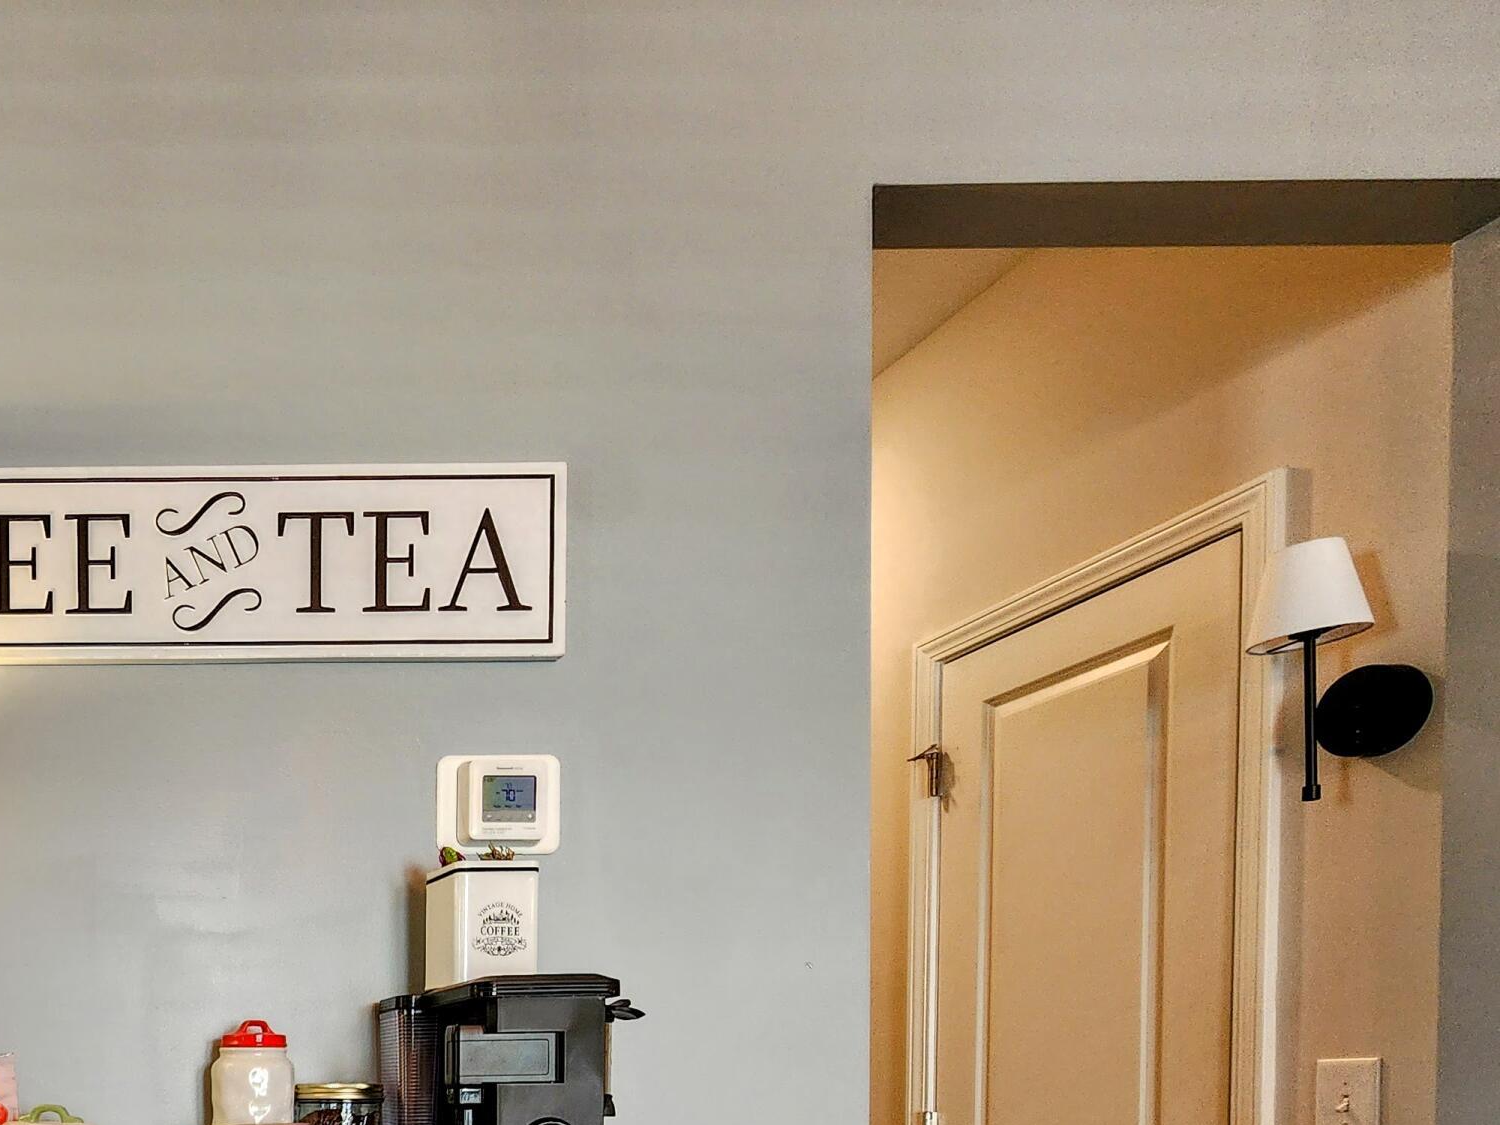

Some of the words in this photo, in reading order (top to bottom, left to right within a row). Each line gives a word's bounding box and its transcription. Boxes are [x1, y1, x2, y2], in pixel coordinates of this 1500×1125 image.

[163, 523, 261, 599] AND
[277, 506, 534, 614] TEA
[477, 901, 504, 917] VINTAGE
[505, 902, 523, 918] HOME
[480, 925, 520, 936] COFFEE
